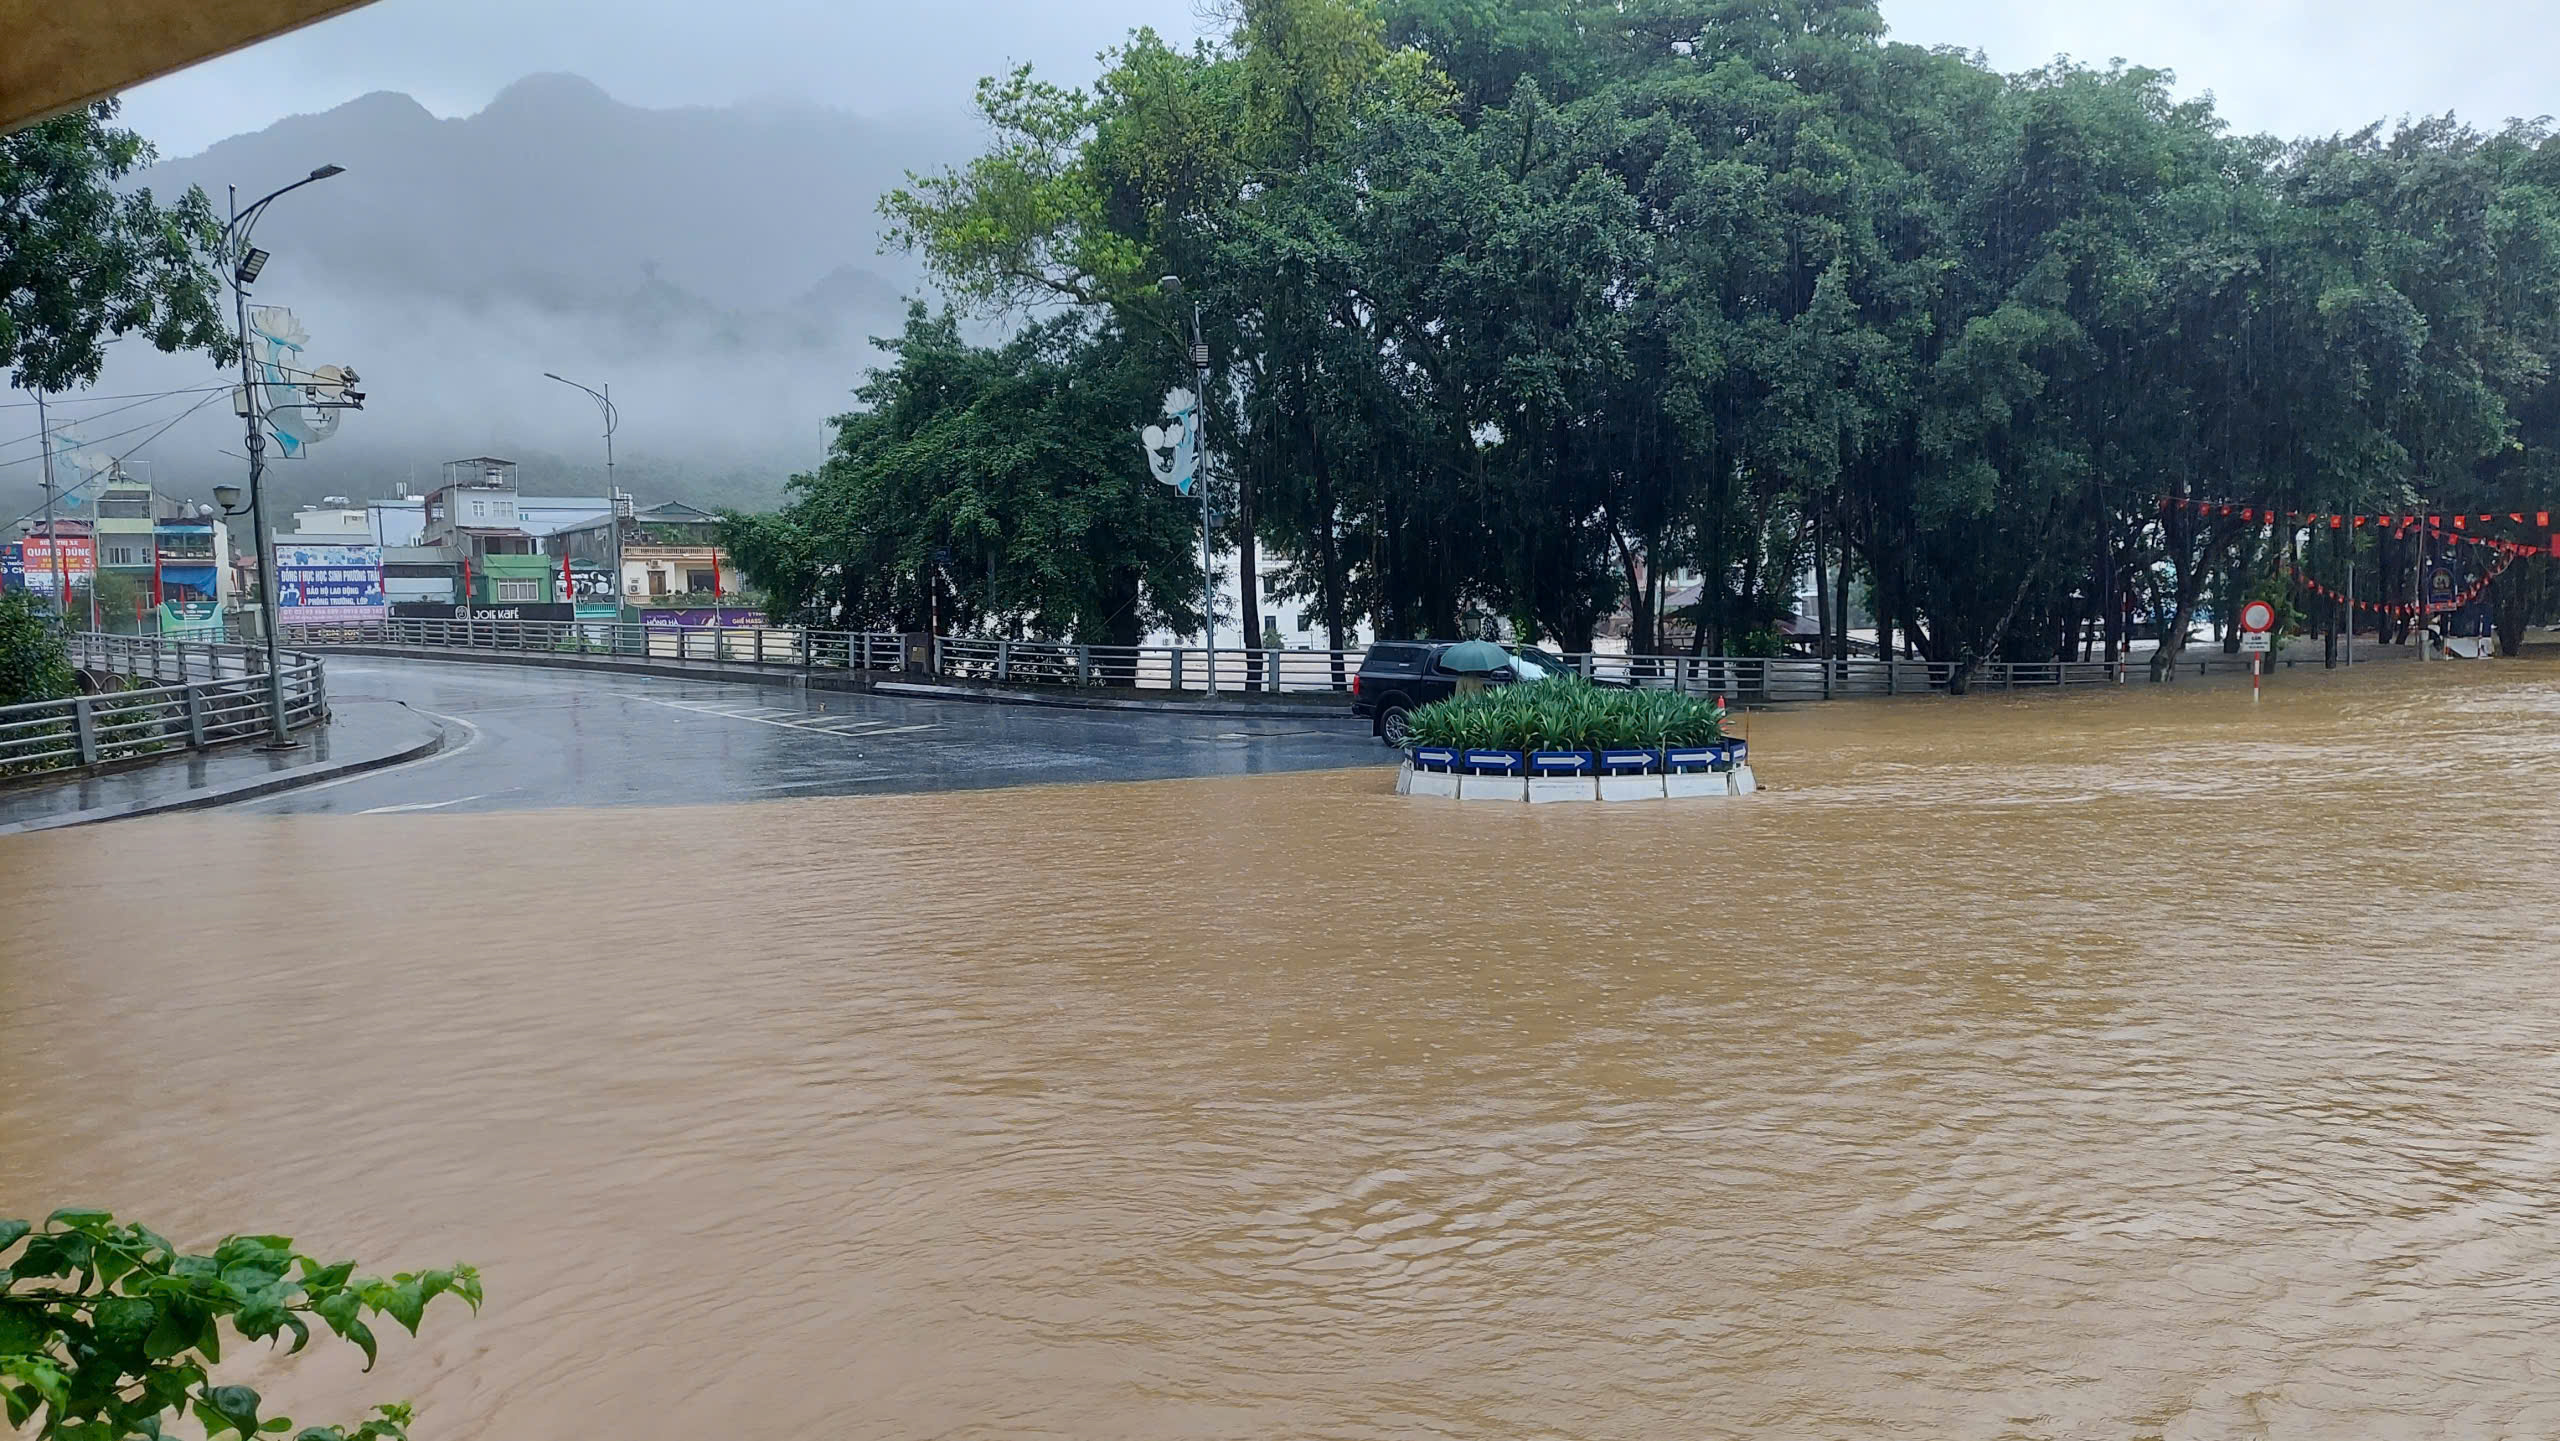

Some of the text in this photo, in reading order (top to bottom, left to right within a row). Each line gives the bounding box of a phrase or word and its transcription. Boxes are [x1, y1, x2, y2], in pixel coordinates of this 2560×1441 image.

[27, 548, 61, 556] QUAG
[315, 570, 328, 584] HỌC
[328, 570, 342, 582] SINH
[330, 586, 341, 595] LAO
[473, 610, 497, 619] JOIE
[669, 617, 678, 625] HÀ
